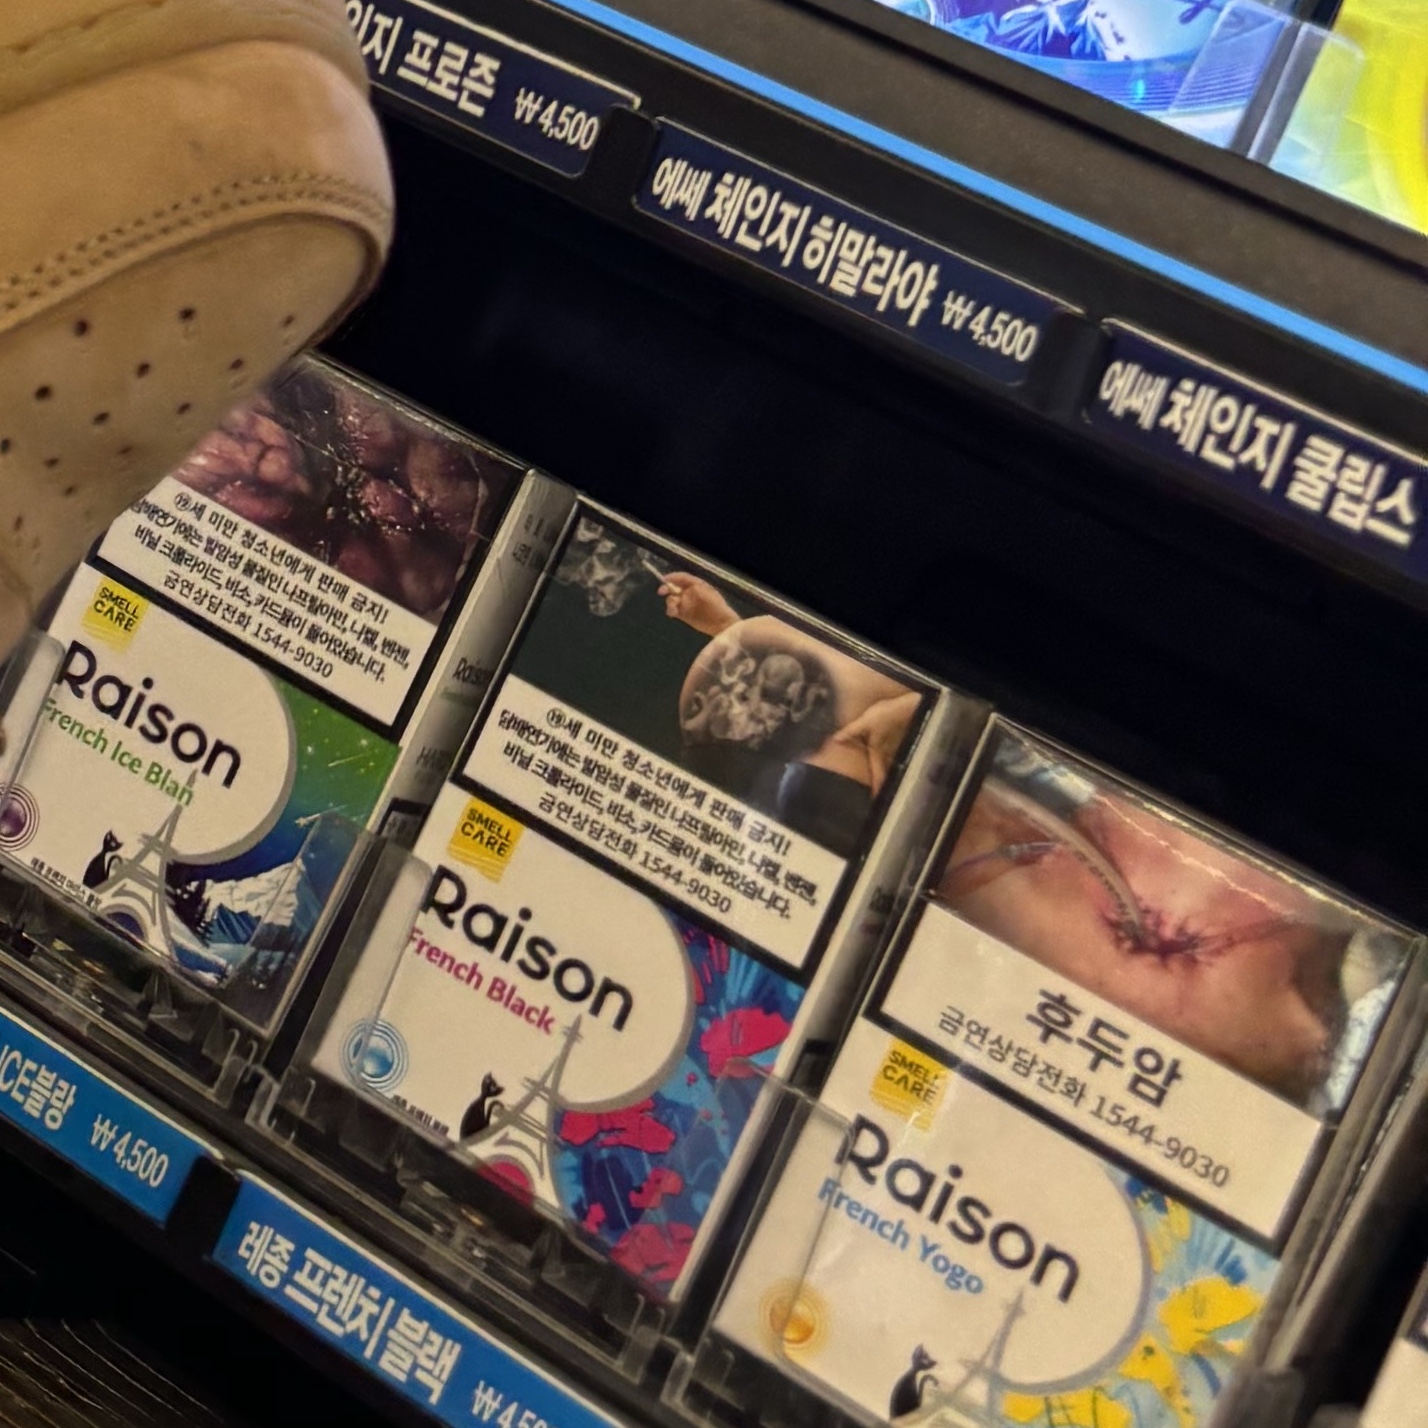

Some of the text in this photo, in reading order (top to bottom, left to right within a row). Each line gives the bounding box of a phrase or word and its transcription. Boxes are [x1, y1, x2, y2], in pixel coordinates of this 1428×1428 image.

[397, 29, 502, 119] 프로즌
[514, 87, 600, 151] ₩4,500
[650, 152, 1040, 364] 에쎄 체인지 히말라야 ₩4,500
[1099, 360, 1169, 431] 에쎄
[1160, 377, 1298, 492] 체인지
[92, 597, 136, 632] CARE
[97, 586, 141, 621] SMELL
[162, 569, 334, 680] 금연상담전화 1544-9030
[41, 698, 108, 753] French
[110, 741, 143, 774] Ice
[54, 640, 244, 790] Raison
[405, 927, 558, 1038] French Black
[420, 864, 637, 1033] Raison
[937, 1003, 1233, 1189] 금연상담전화 1544-9030
[1024, 985, 1187, 1109] 후두암
[89, 1111, 171, 1192] ₩4,500
[835, 1113, 1082, 1304] Raison
[818, 1175, 987, 1298] French Yogo
[238, 1220, 463, 1407] 레종 프렌치 블랙
